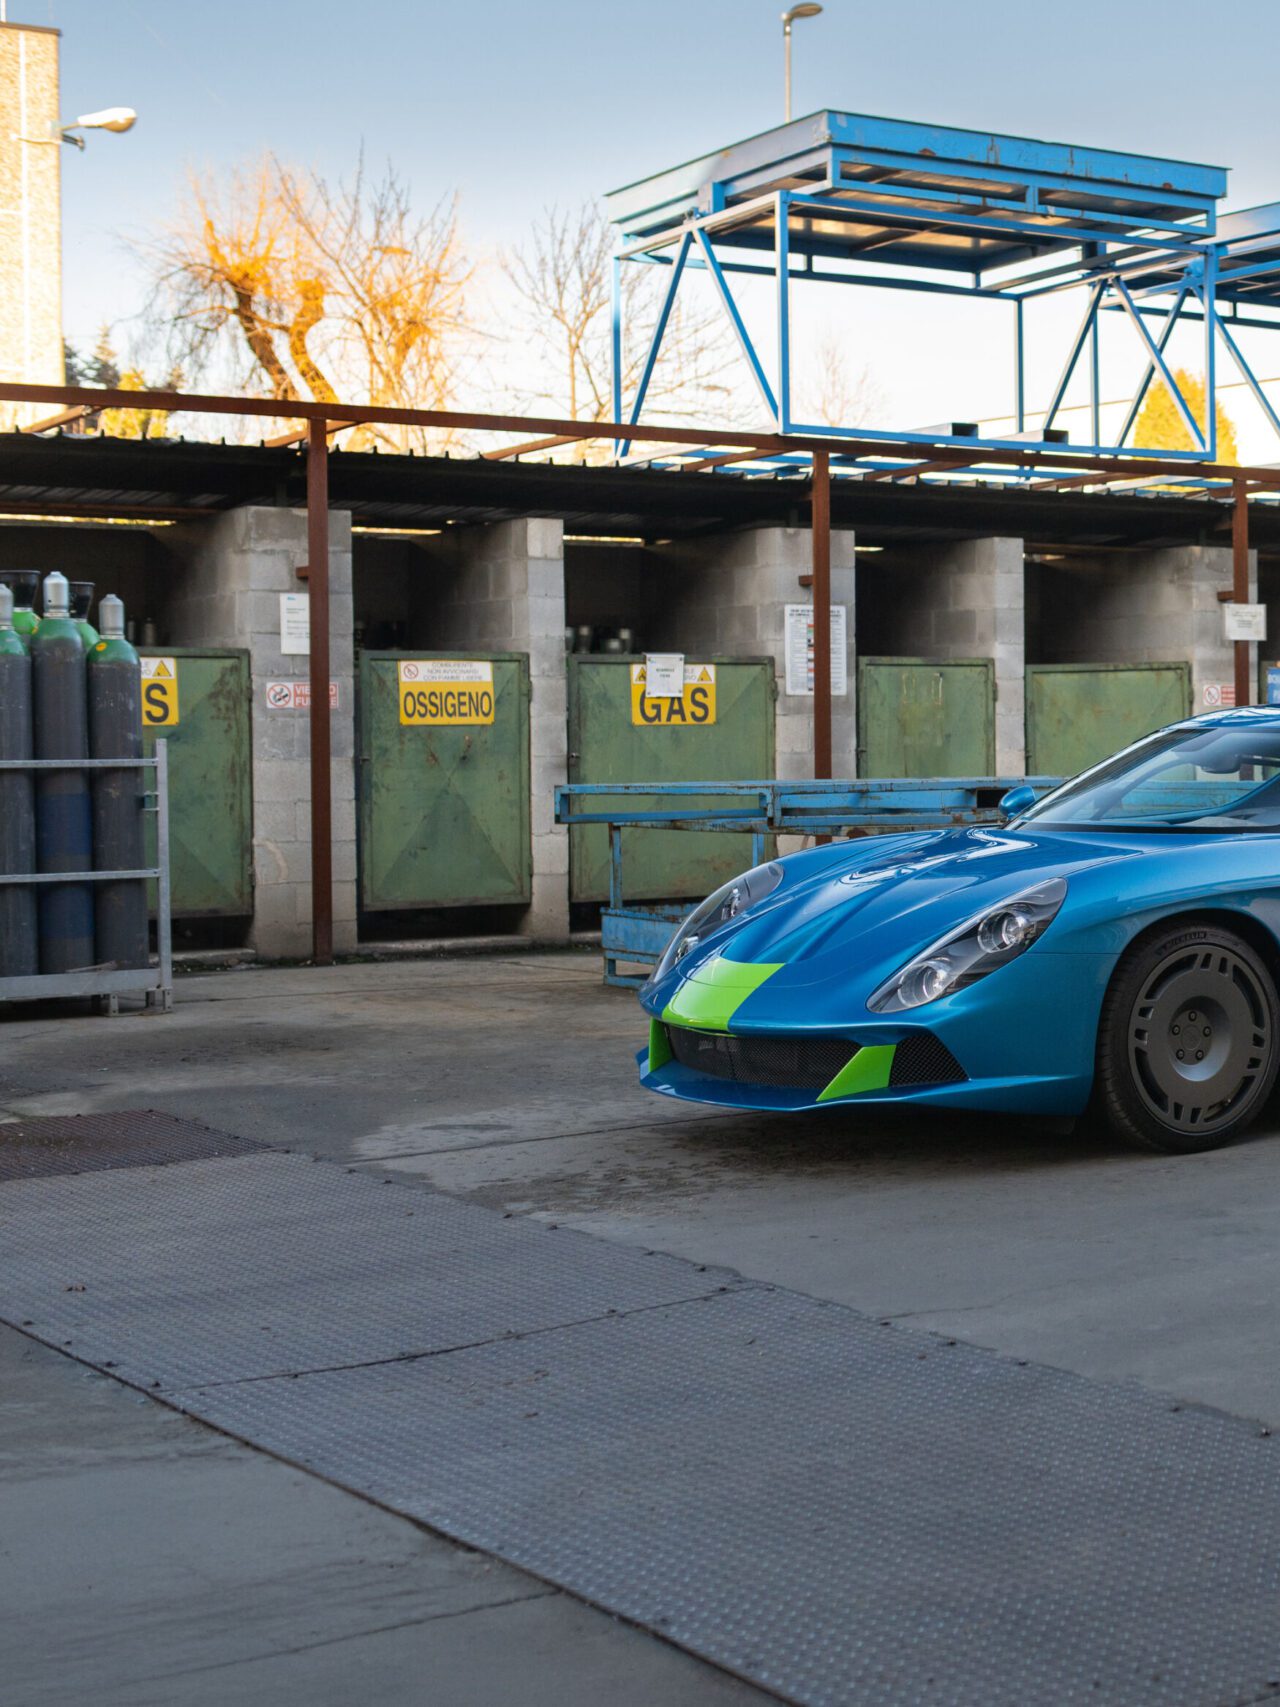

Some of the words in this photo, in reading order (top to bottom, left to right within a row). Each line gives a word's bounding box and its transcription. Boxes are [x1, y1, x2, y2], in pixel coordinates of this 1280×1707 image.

[295, 685, 336, 695] VIEO
[403, 691, 492, 718] OSSIGENO
[640, 687, 709, 722] GAS
